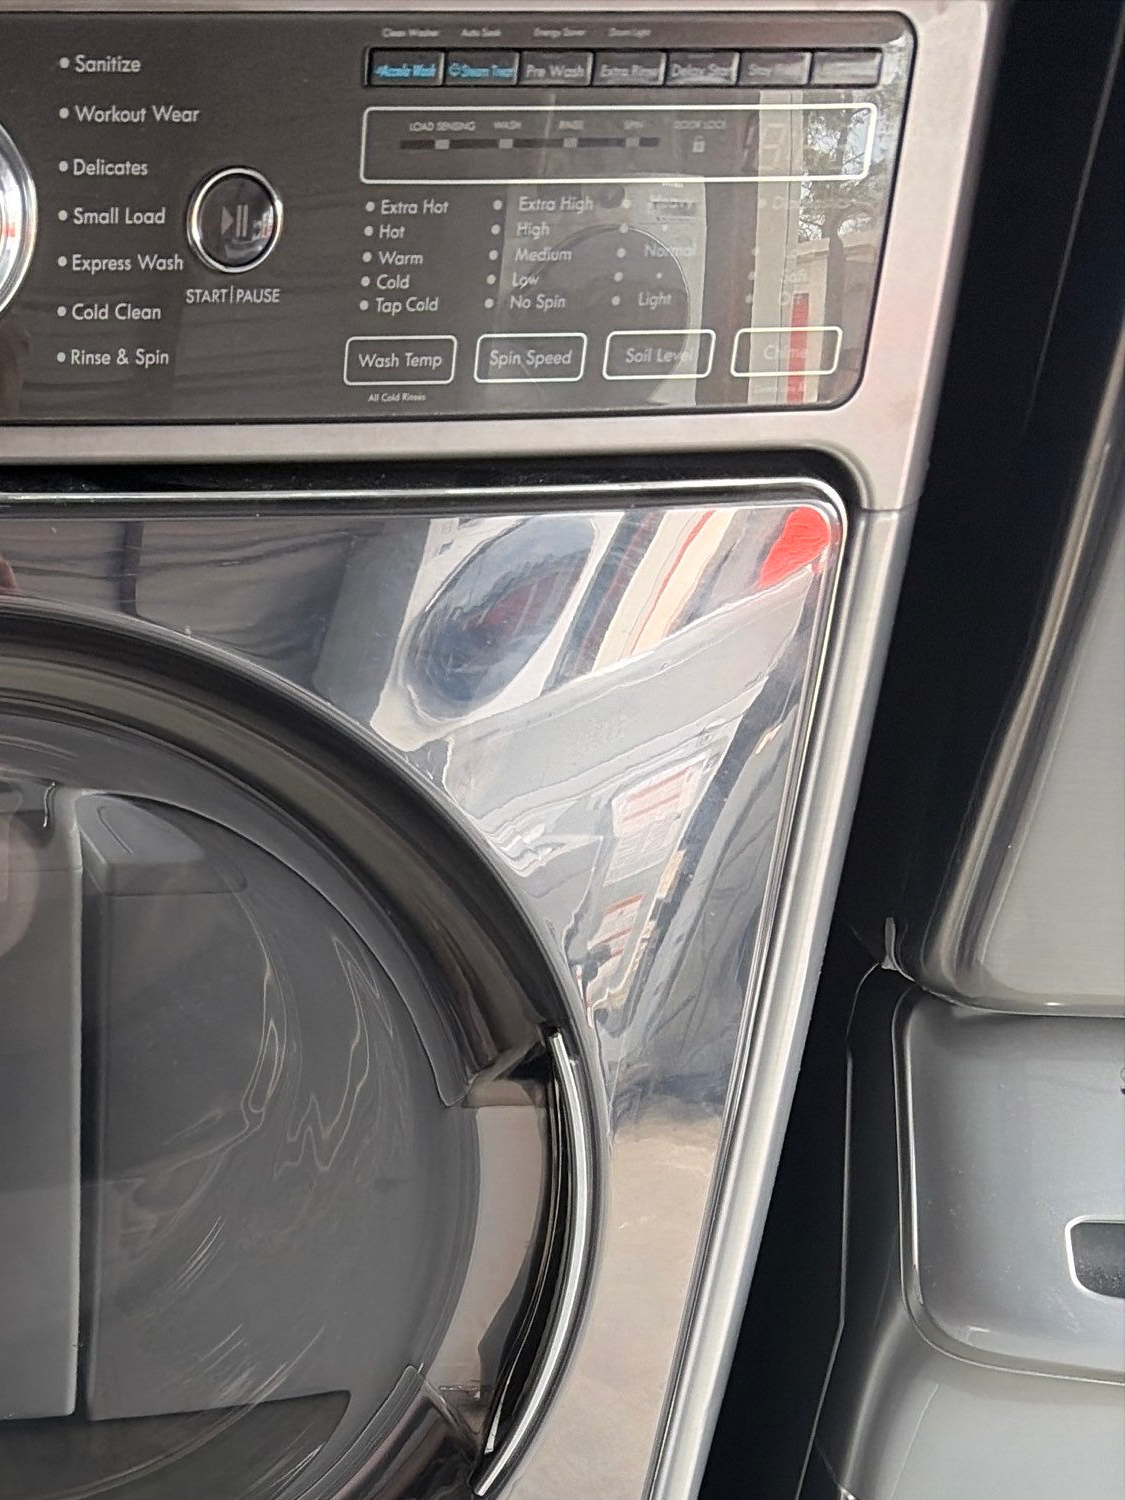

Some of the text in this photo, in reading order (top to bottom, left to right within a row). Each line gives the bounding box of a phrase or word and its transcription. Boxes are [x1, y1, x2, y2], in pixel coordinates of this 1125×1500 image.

[75, 54, 141, 73] Sanitize
[526, 64, 585, 78] Pre Wash
[600, 64, 628, 78] Extra
[75, 105, 200, 123] Workout Wear
[409, 120, 476, 132] LOAD SENSING
[73, 158, 148, 176] Delicates
[381, 199, 449, 214] Extra Hot
[518, 196, 594, 214] Extra High
[73, 207, 166, 224] Small Load
[379, 223, 405, 239] Hot
[516, 221, 550, 239] High
[378, 250, 424, 265] Warm
[514, 247, 572, 263] Medium
[643, 243, 696, 258] Normal
[72, 254, 184, 275] Express Wash
[376, 273, 410, 290] Cold
[512, 271, 539, 287] Low
[376, 296, 438, 316] Tap Cold
[510, 293, 566, 312] No Spin
[638, 291, 672, 310] Light
[72, 302, 162, 321] Cold Clean
[71, 348, 169, 368] Rinse & Spin
[358, 352, 442, 370] Wash Temp
[489, 349, 572, 368] Spin Speed
[625, 346, 695, 363] Soil Level
[368, 392, 426, 402] All Cold Rinses
